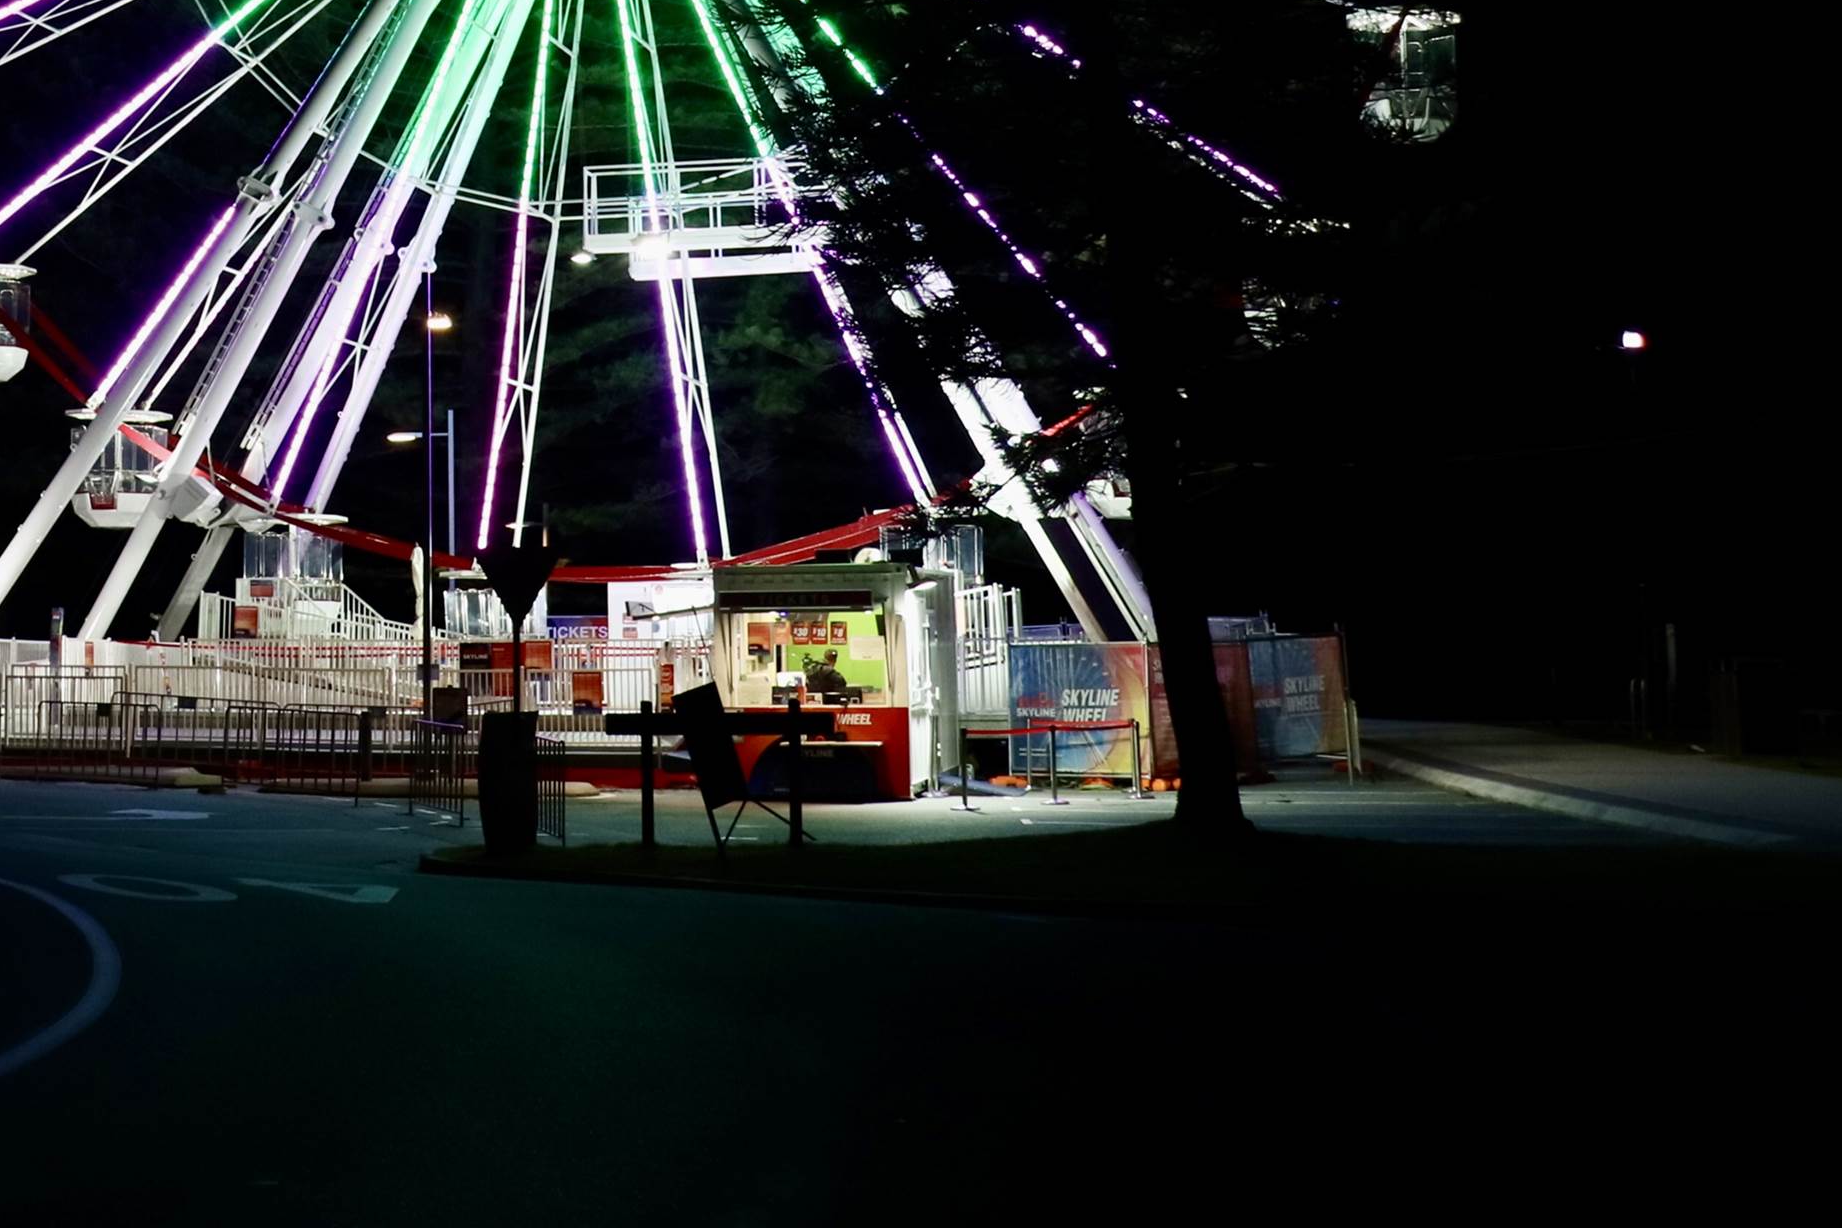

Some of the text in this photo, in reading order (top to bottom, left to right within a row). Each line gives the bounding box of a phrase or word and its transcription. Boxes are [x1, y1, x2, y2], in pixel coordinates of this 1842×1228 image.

[546, 626, 608, 639] TICKETS
[1284, 675, 1326, 693] SKYLINE
[1061, 688, 1120, 707] SKYLINE
[1284, 694, 1321, 712] WHEEL
[836, 713, 873, 726] WHEEL
[1016, 707, 1056, 718] SKYLINE
